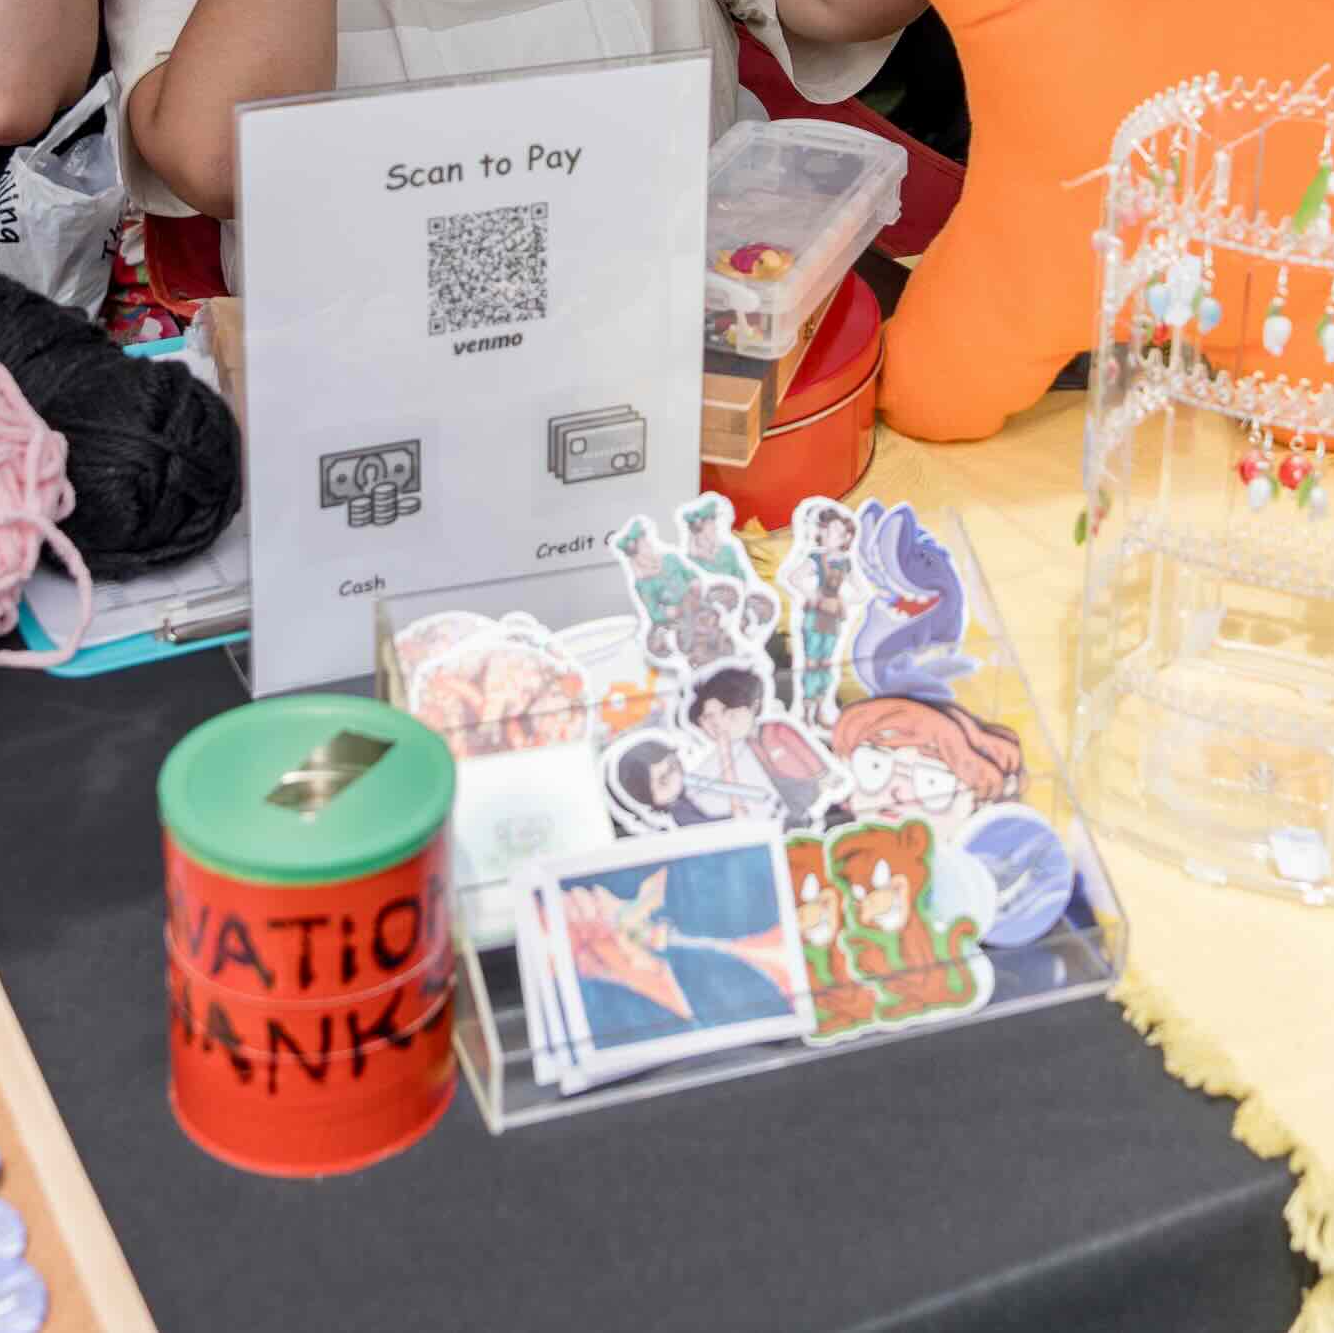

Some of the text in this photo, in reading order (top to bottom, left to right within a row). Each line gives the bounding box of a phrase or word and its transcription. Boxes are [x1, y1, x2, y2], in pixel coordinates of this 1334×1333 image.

[385, 143, 583, 191] Scan to Pay
[453, 331, 524, 356] venmo
[535, 535, 596, 560] Credit
[338, 574, 387, 598] Cash
